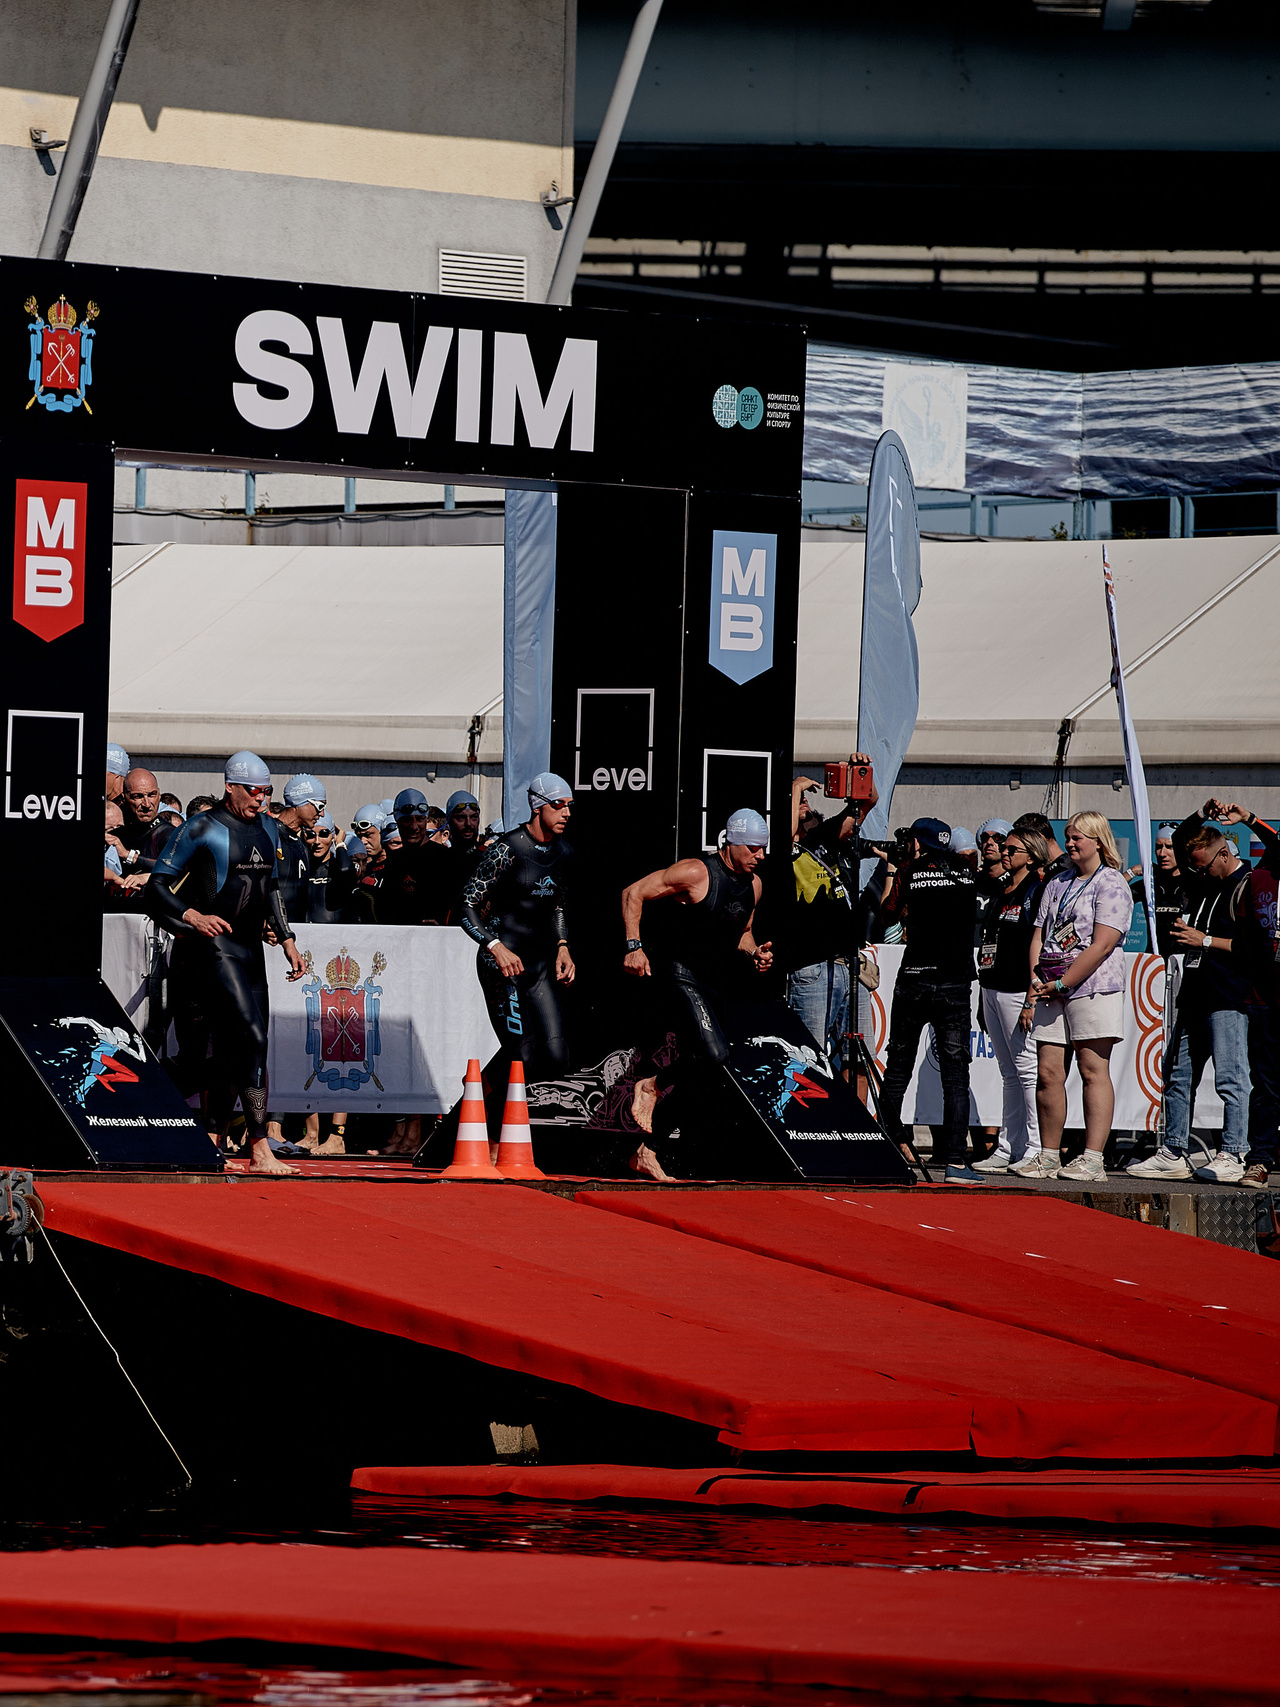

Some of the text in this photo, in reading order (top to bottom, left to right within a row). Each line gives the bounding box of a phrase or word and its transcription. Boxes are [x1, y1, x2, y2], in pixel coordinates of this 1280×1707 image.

[232, 309, 598, 452] SWIM
[766, 393, 791, 402] КОМИТЕТ
[766, 402, 801, 411] ФИЗИЧЕСКОЙ
[766, 411, 790, 420] КУЛЬТУРЕ
[771, 420, 792, 428] СПОРТУ
[574, 750, 654, 791] Level
[4, 775, 81, 821] Level
[85, 1115, 197, 1127] Железный человек
[785, 1130, 886, 1141] Железный человек
